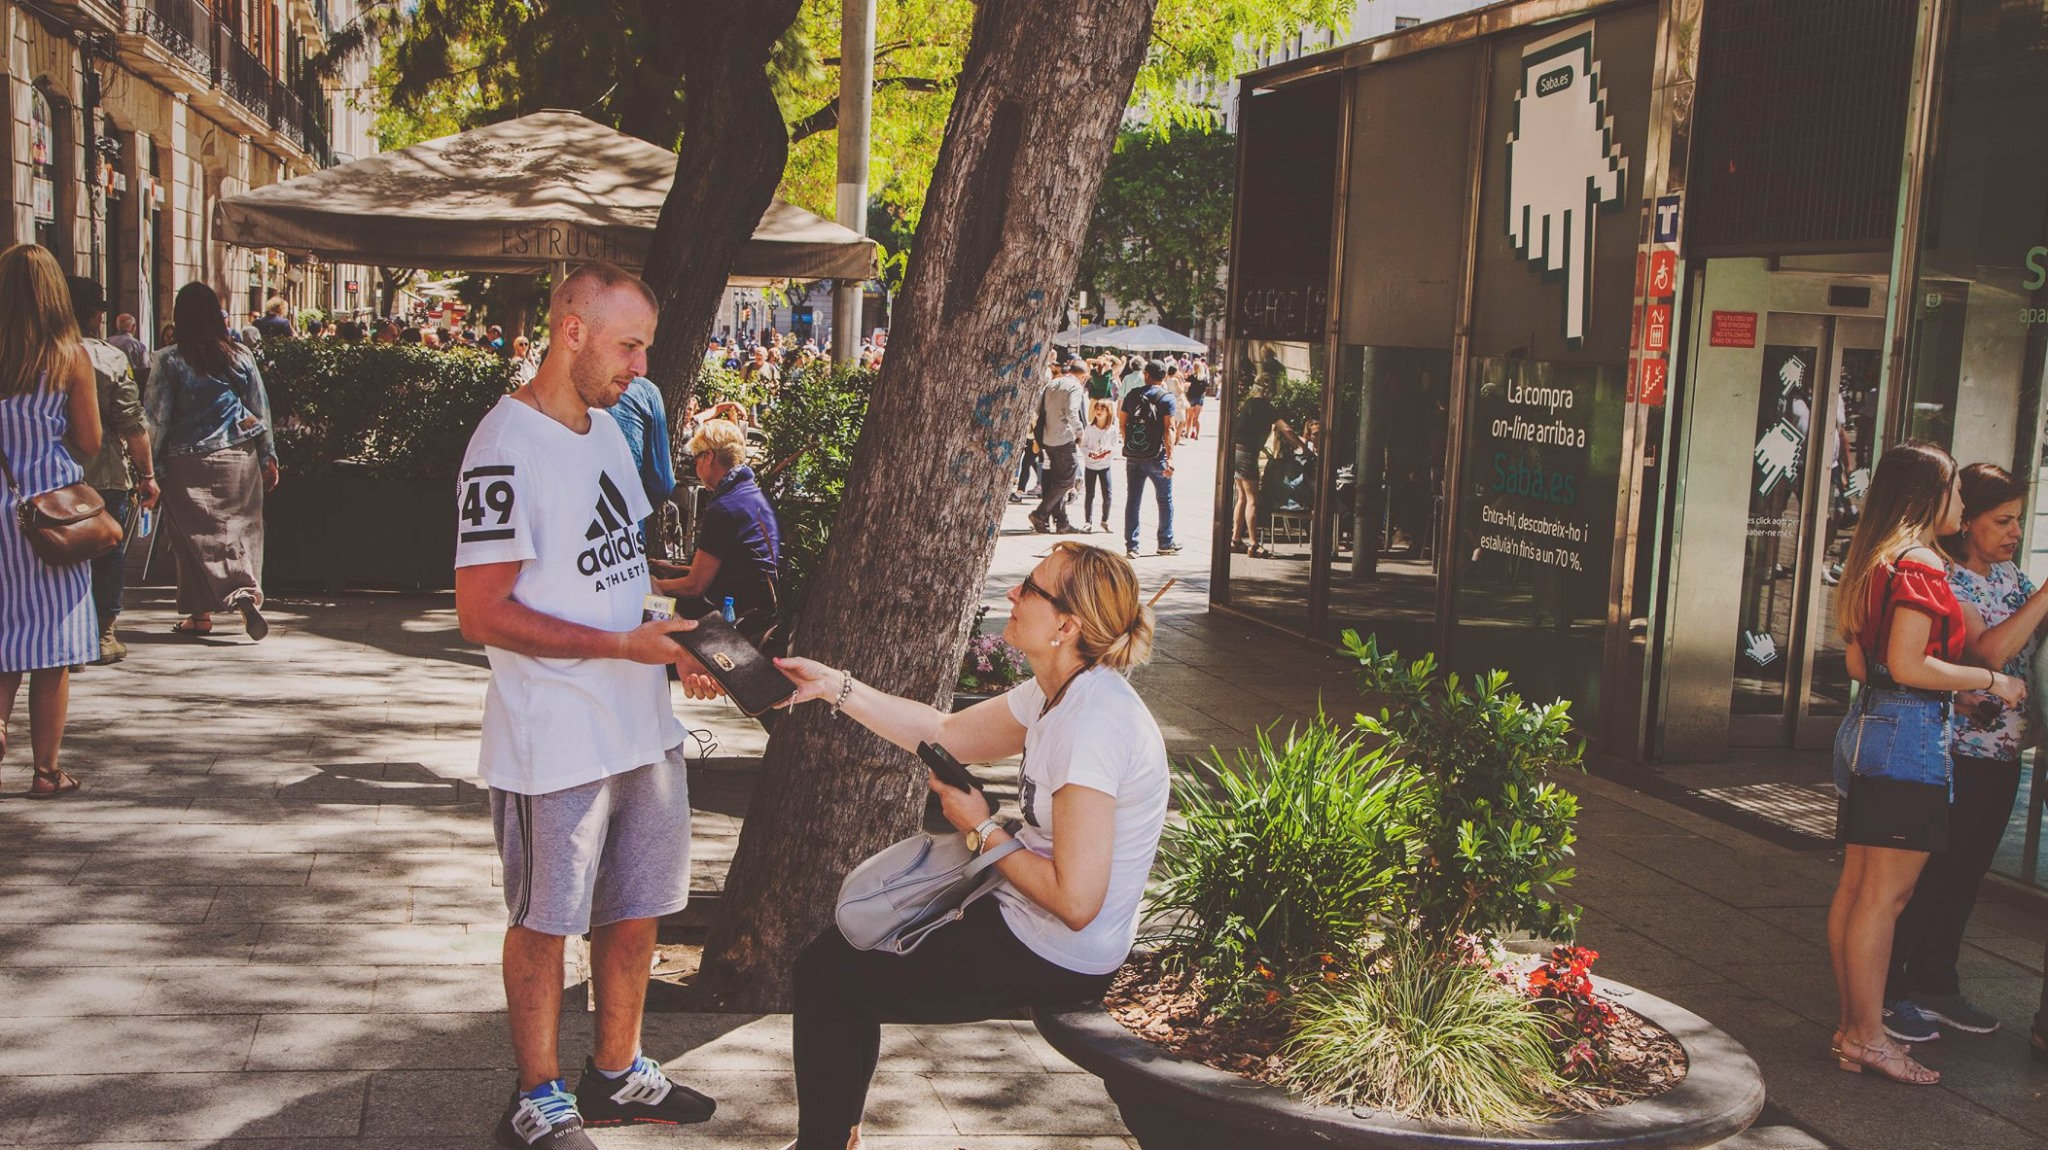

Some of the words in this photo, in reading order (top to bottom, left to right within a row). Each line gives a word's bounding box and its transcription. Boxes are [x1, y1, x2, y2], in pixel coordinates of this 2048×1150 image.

[1541, 73, 1569, 92] Saba.es
[501, 227, 617, 260] ESTRUCH
[1508, 379, 1522, 404] La
[1525, 386, 1573, 415] compra
[1492, 415, 1535, 441] on-line
[1536, 419, 1574, 447] arriba
[1577, 429, 1585, 448] a
[1491, 450, 1576, 504] Saba.es
[462, 480, 515, 526] 49
[1482, 505, 1516, 530] Entra-hi,
[1518, 513, 1580, 541] descobreix-ho
[1584, 523, 1588, 543] i
[1755, 517, 1771, 525] click
[1788, 519, 1799, 527] per
[1480, 535, 1518, 556] estalvia'n
[1520, 540, 1534, 560] fins
[1535, 548, 1541, 561] a
[1542, 548, 1554, 565] un
[1555, 549, 1568, 567] 70
[1570, 552, 1582, 571] %.
